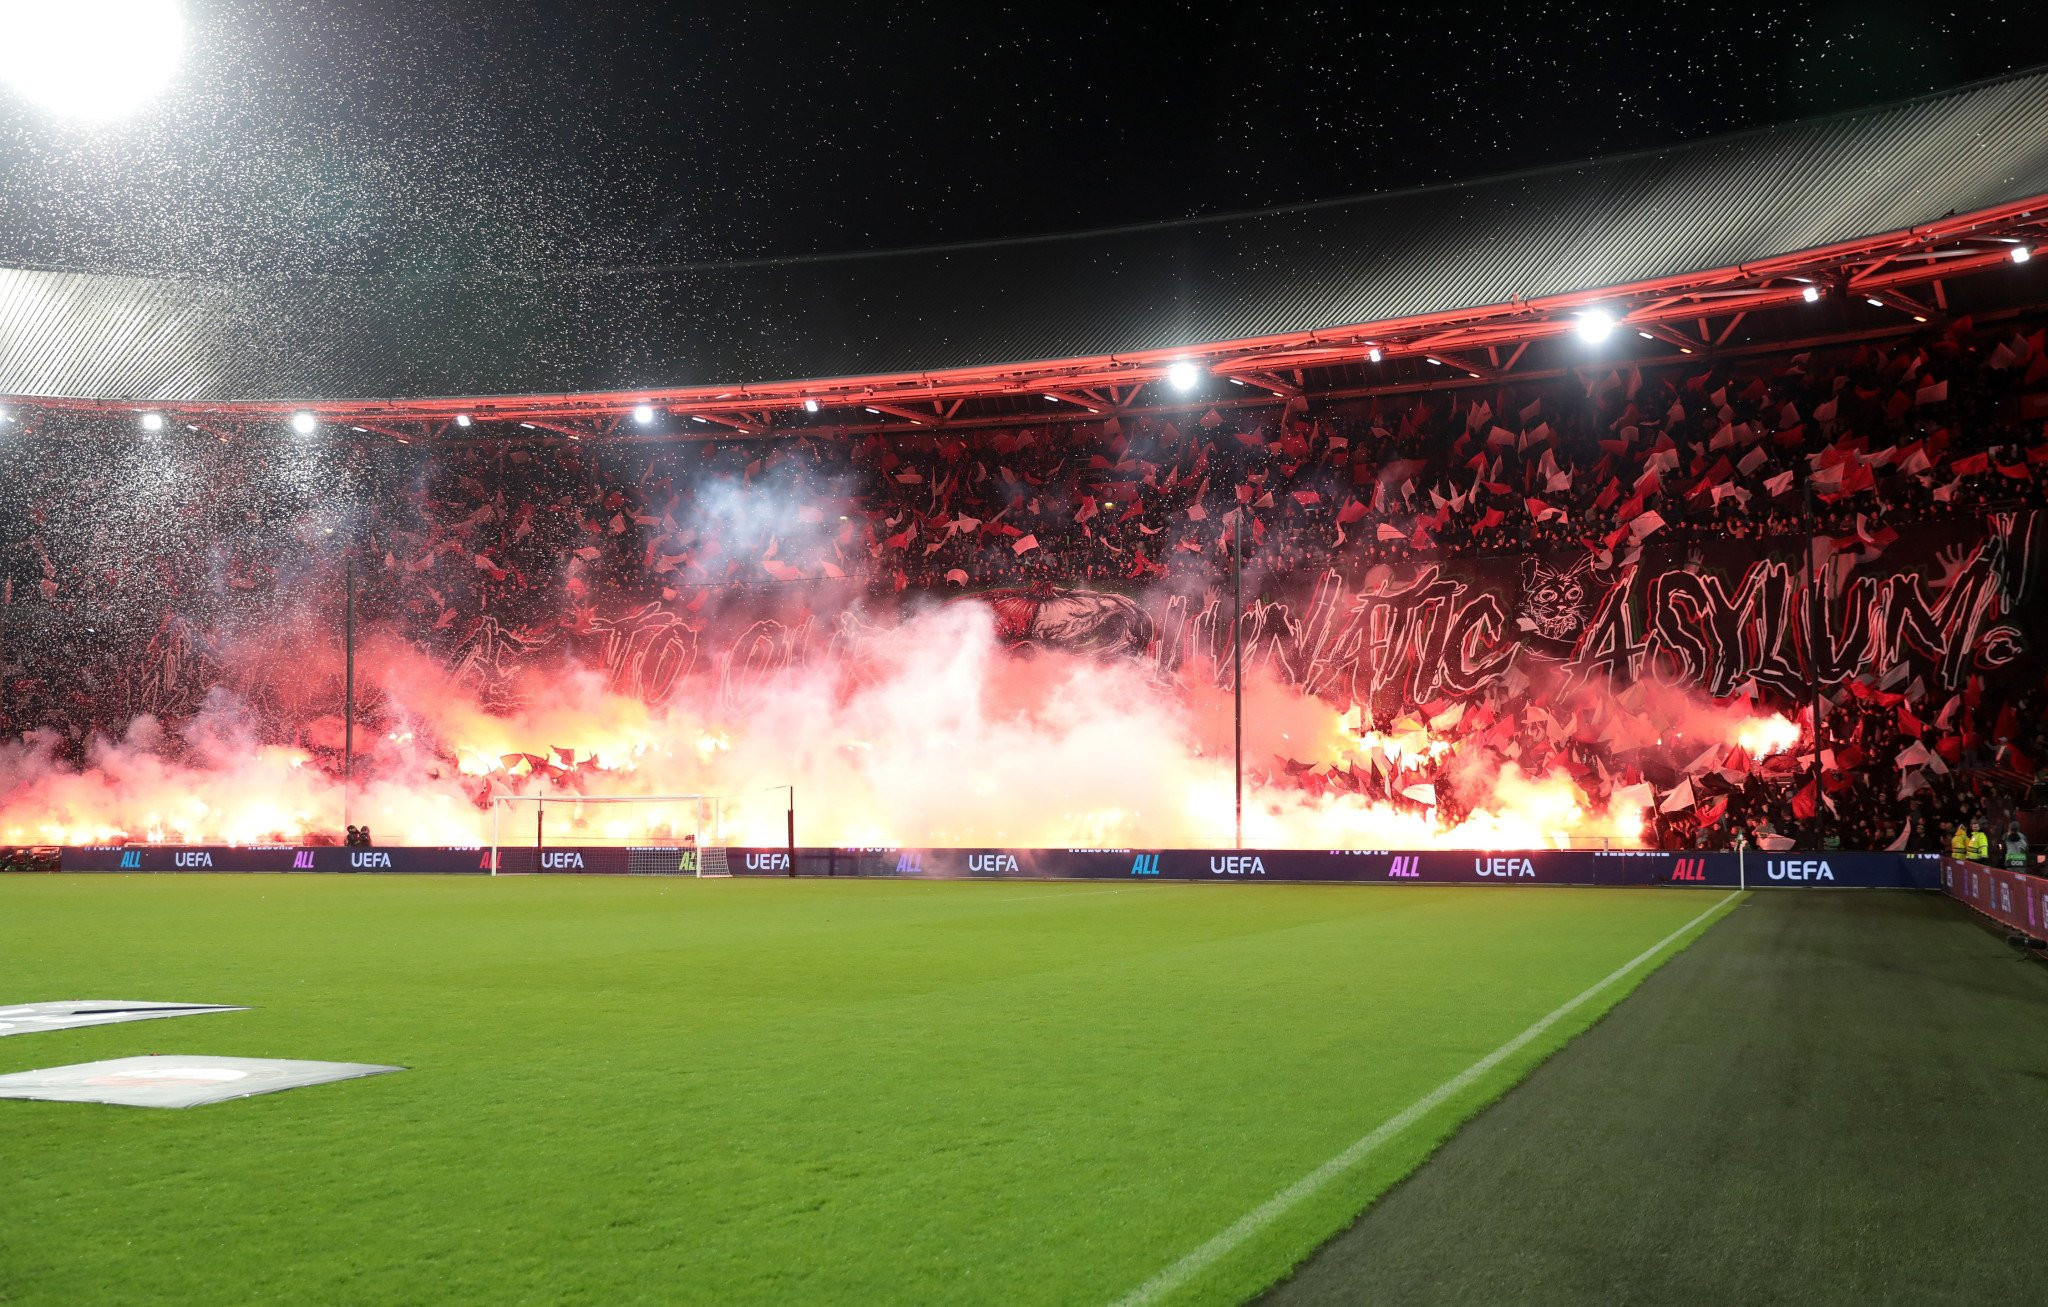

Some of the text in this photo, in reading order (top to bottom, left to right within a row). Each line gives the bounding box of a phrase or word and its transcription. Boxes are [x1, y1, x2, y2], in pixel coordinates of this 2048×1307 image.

[1555, 510, 2038, 704] ASYLUM!
[120, 851, 141, 868] ALL
[175, 852, 213, 867] UEFA
[293, 851, 315, 869] ALL
[351, 852, 392, 868] UEFA
[541, 852, 584, 868] UEFA
[746, 853, 790, 870] UEFA
[896, 854, 922, 872] ALL
[968, 854, 1019, 871] UEFA
[1131, 854, 1160, 875] ALL
[1210, 856, 1266, 874] UEFA
[1388, 856, 1420, 877] ALL
[1475, 858, 1536, 877] UEFA
[1671, 858, 1706, 881] ALL
[1767, 860, 1834, 880] UEFA
